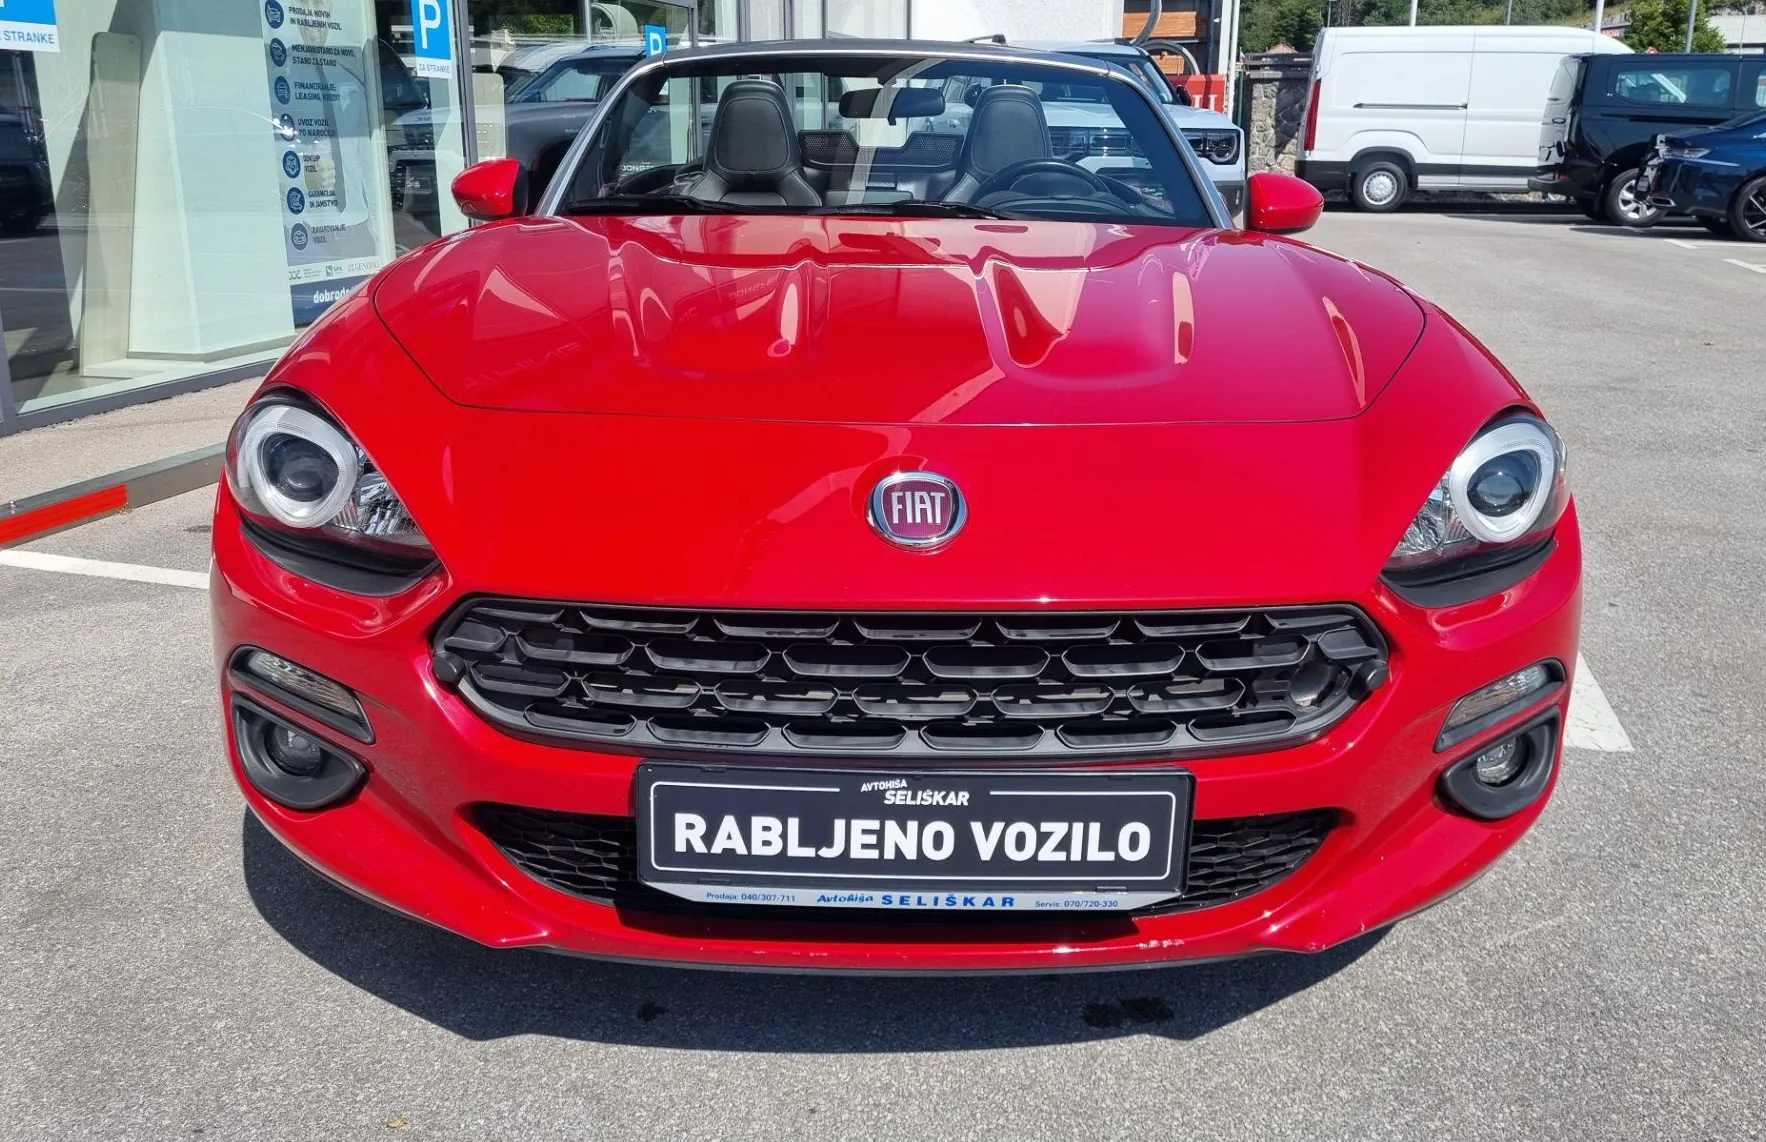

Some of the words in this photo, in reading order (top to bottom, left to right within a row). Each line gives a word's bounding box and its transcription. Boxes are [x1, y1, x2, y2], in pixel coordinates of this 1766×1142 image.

[288, 6, 313, 16] PRODAJA
[314, 10, 331, 19] NOVIH
[290, 17, 296, 25] IN
[297, 18, 327, 28] RABLJENIH
[419, 0, 441, 49] P
[3, 30, 56, 44] STRANKE
[292, 56, 311, 65] STARO
[297, 118, 313, 127] UVOZ
[891, 491, 945, 524] FIAT
[860, 778, 907, 792] AVTOHIŠA
[883, 789, 970, 806] SELIŠKAR
[674, 813, 955, 861] RABLJENO
[969, 821, 1151, 862] VOZILO
[706, 891, 738, 901] Prodaja:
[741, 893, 796, 902] 040/307-711
[816, 893, 874, 905] Avtohiša
[881, 893, 1015, 907] SELIŠKAR
[1035, 899, 1063, 908] Servis:
[1064, 899, 1119, 909] 070/720-330
